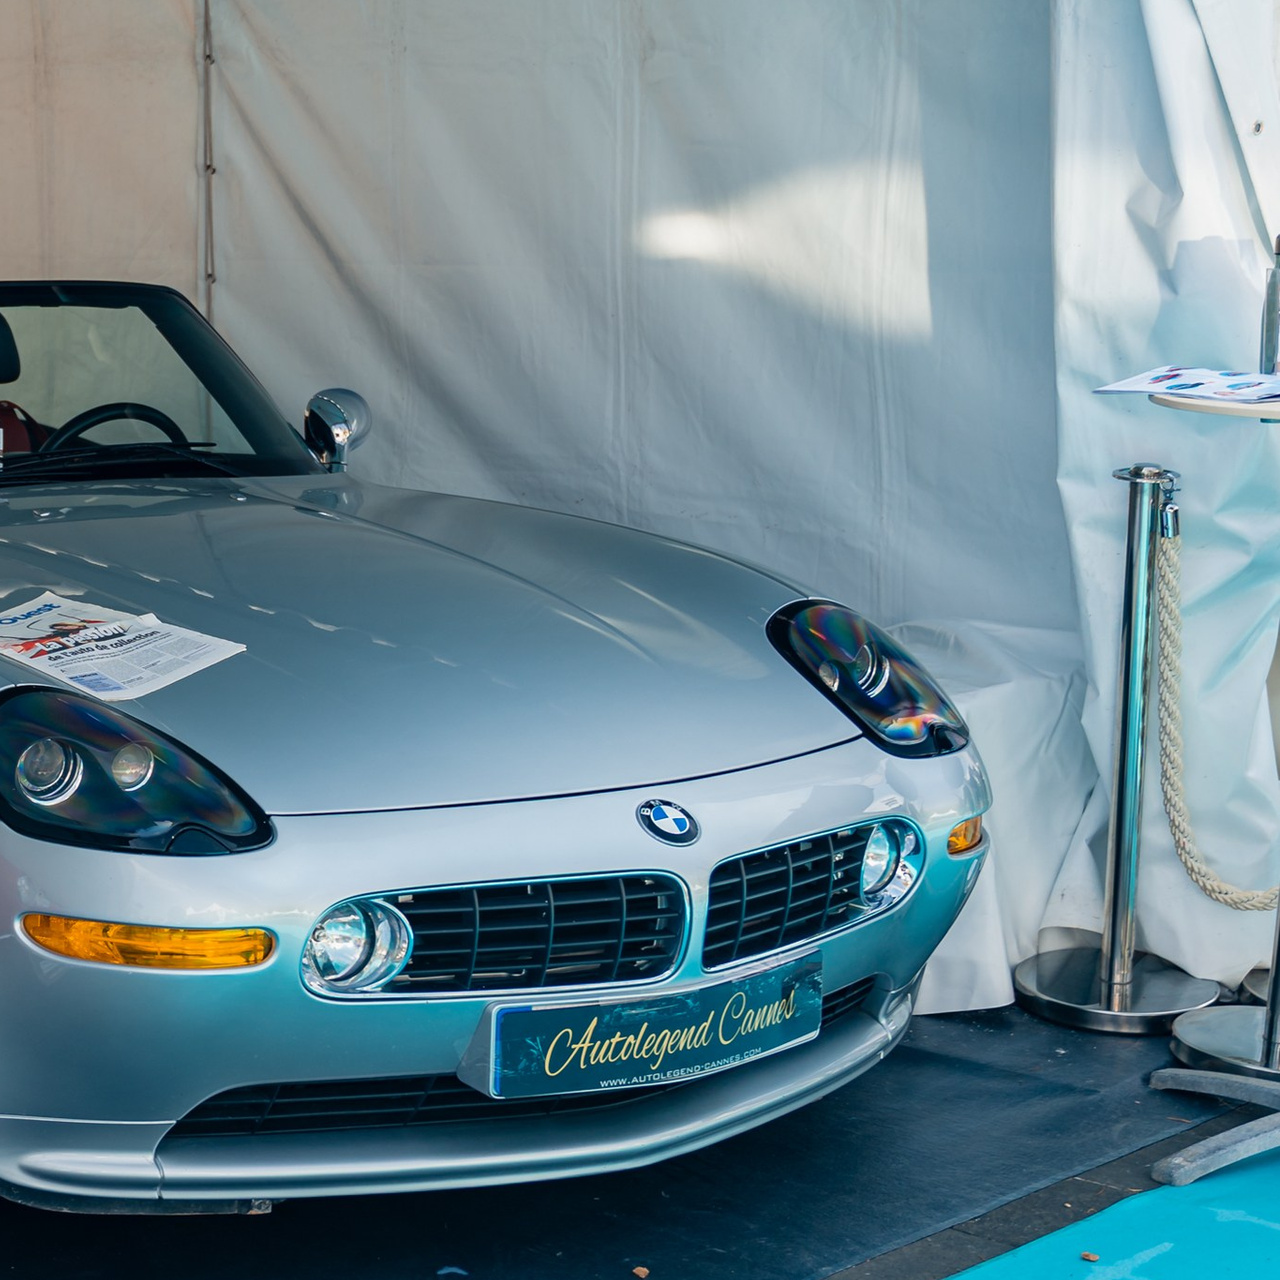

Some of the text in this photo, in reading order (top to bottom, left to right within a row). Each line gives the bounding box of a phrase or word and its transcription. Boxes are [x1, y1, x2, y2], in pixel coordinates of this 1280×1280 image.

[47, 629, 161, 662] de l'auto de collection
[63, 622, 125, 647] passion
[640, 799, 682, 816] BMW
[543, 988, 798, 1078] Autolegend Cannes
[599, 1047, 762, 1088] WWW.AUTOLEGEND-CANNES.COM
